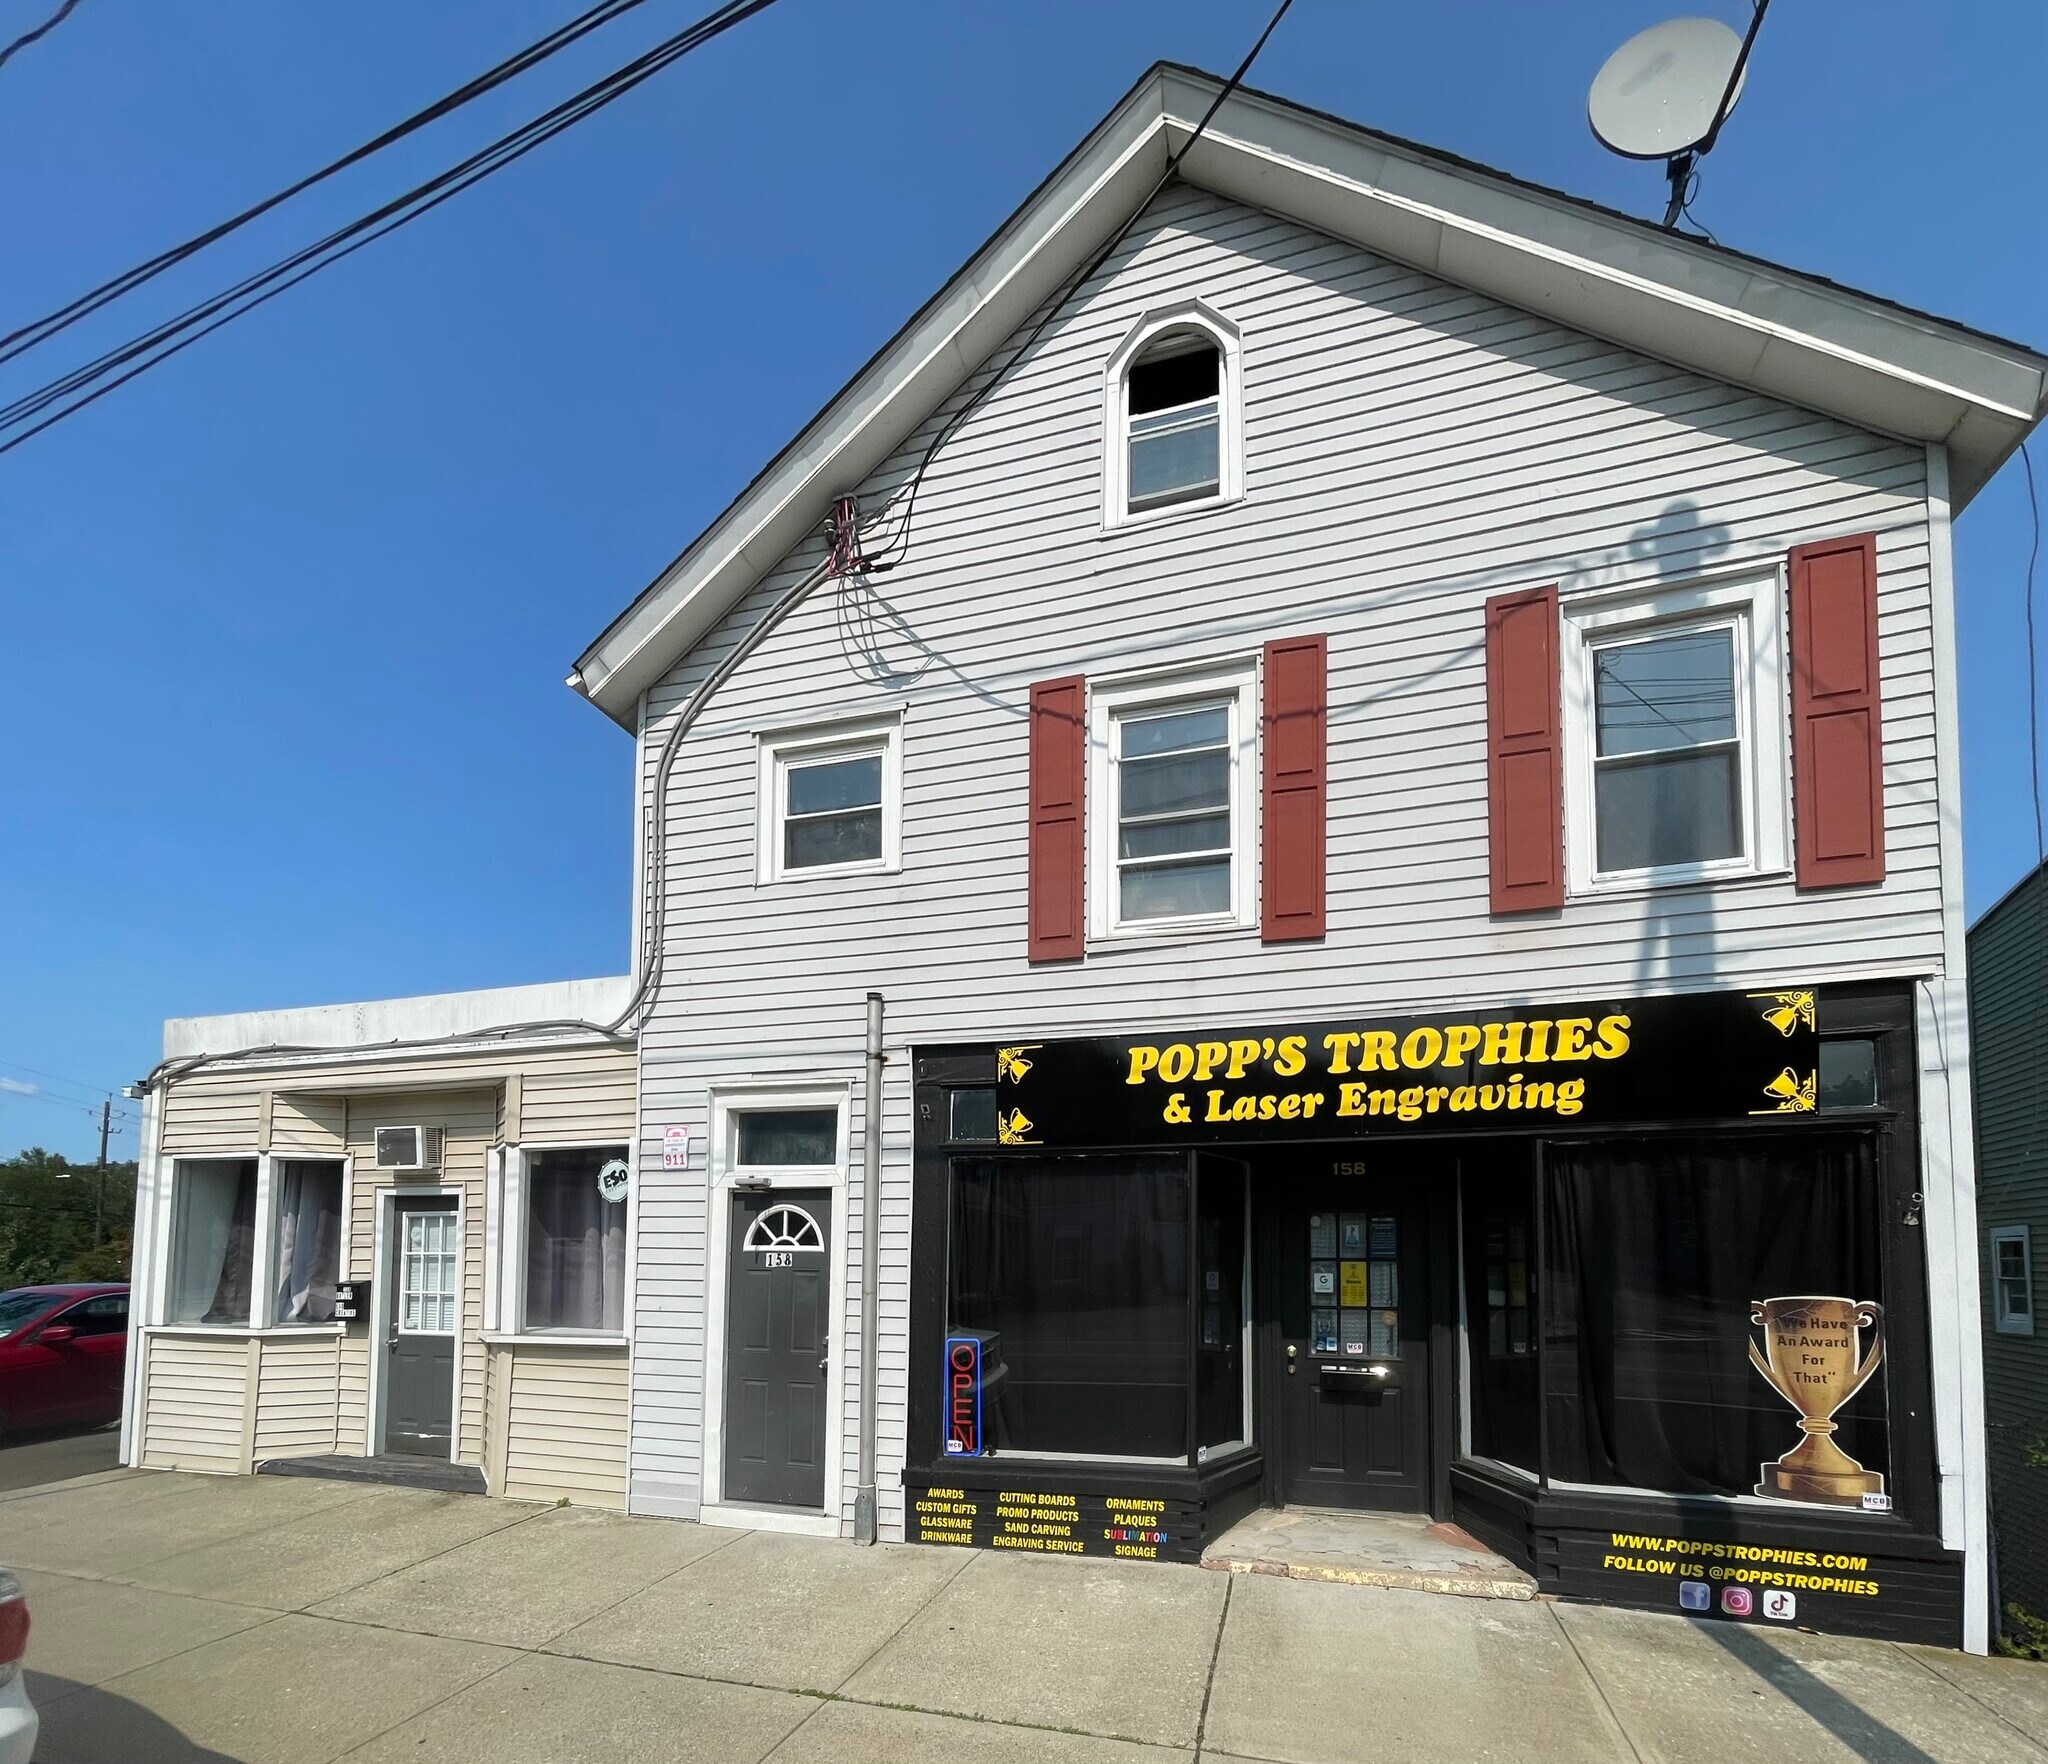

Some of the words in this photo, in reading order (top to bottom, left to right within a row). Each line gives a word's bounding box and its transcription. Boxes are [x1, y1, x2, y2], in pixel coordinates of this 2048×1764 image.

[1125, 1035, 1308, 1085] POPP'S
[1323, 1014, 1632, 1075] TROPHIES
[1163, 1093, 1192, 1124] &
[1204, 1089, 1325, 1121] Laser
[1336, 1073, 1586, 1121] Engraving
[665, 1154, 686, 1166] 911
[1332, 1162, 1366, 1176] 158
[603, 1169, 628, 1189] ESO
[768, 1253, 792, 1267] 158
[1810, 1318, 1848, 1330] Have
[1777, 1335, 1797, 1347] An
[1800, 1336, 1849, 1348] Award
[1802, 1354, 1826, 1366] For
[951, 1344, 975, 1451] OPEN
[927, 1487, 965, 1500] AWARDS
[999, 1492, 1036, 1504] CUTTING
[1038, 1494, 1076, 1507] BOARDS
[916, 1501, 951, 1514] CUSTOM
[952, 1503, 977, 1515] GIFTS
[1105, 1498, 1165, 1512] ORNAMENTS
[996, 1506, 1029, 1519] PROMO
[1031, 1508, 1079, 1522] PRODUCTS
[1113, 1514, 1157, 1527] PLAQUES
[920, 1516, 973, 1529] GLASSWARE
[1004, 1522, 1029, 1534] SAND
[1031, 1523, 1071, 1537] CARVING
[921, 1530, 973, 1544] DRINKWARE
[1104, 1529, 1168, 1543] SUBLIMATION
[993, 1536, 1044, 1550] ENGRAVING
[1045, 1540, 1084, 1553] SERVICE
[1114, 1545, 1157, 1558] SIGNAGE
[1611, 1533, 1868, 1571] WWW.POPPSTROPHIES.COM
[1603, 1555, 1676, 1575] FOLLOW
[1680, 1564, 1704, 1578] US
[1709, 1566, 1879, 1596] @POPPSTROPHIES
